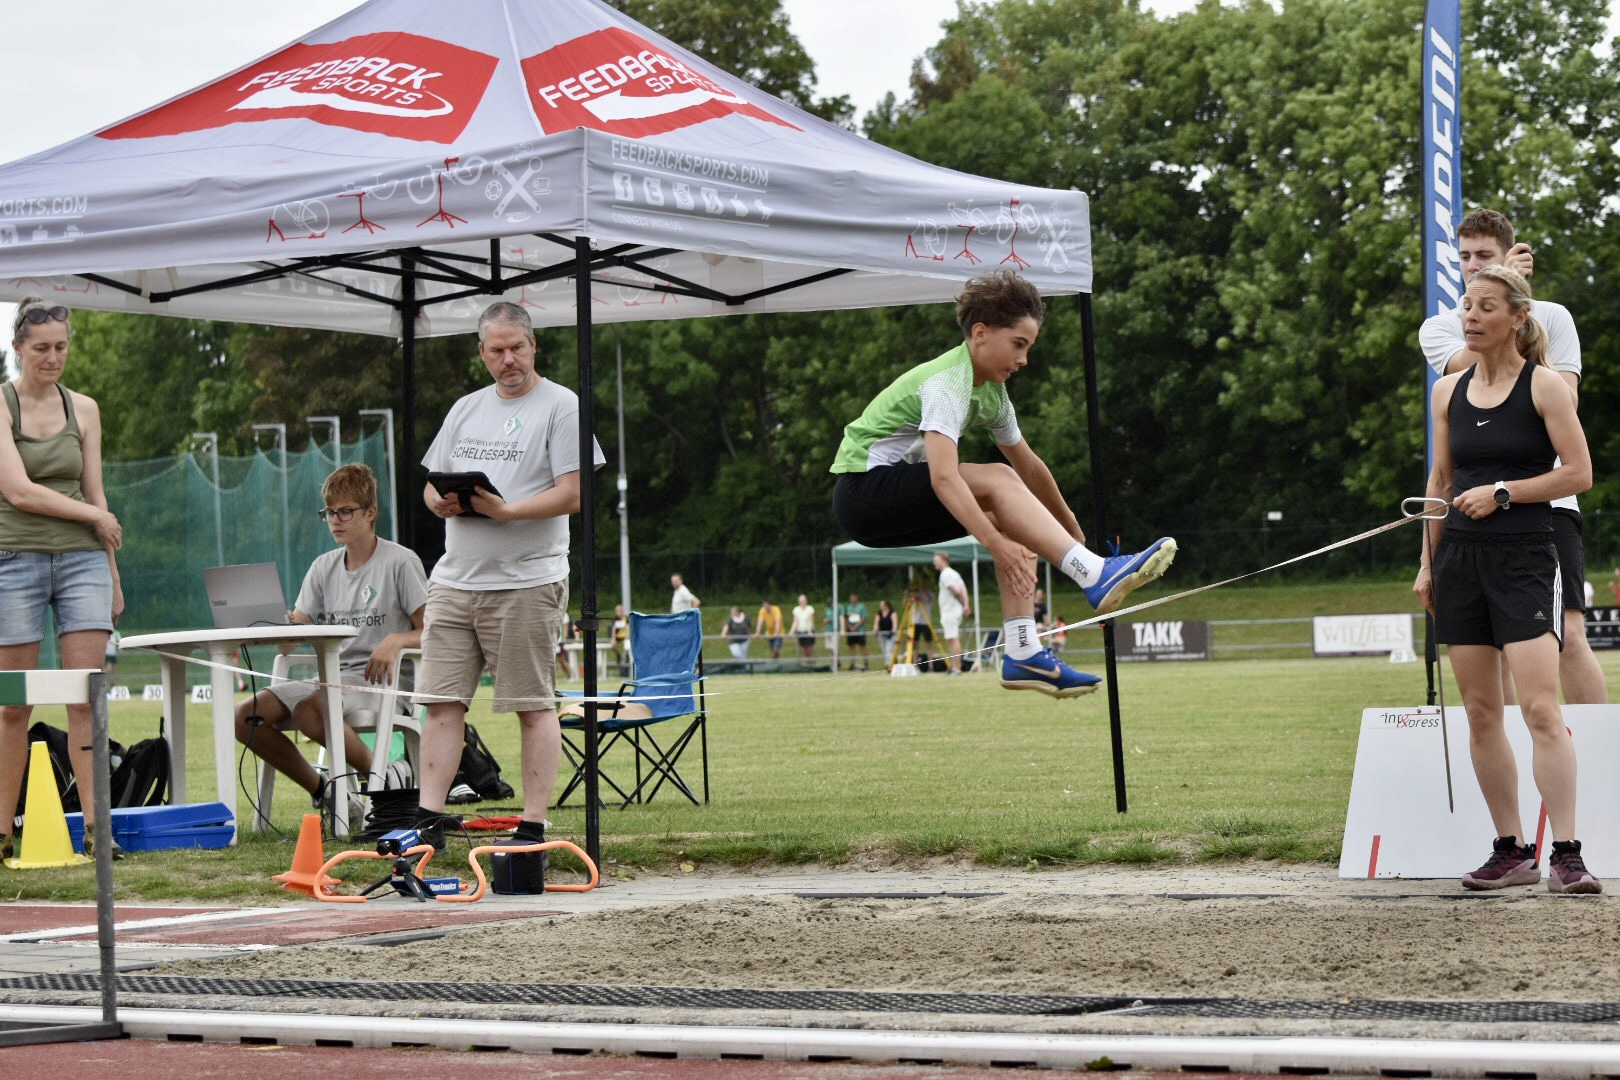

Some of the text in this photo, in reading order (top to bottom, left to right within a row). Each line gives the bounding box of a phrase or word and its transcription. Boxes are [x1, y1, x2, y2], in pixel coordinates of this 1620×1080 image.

[237, 56, 443, 91] FEEDBACK
[311, 76, 423, 105] SPORTS
[611, 140, 769, 187] FEEDBACKSPORTS.COM
[0, 196, 88, 215] ORTS.COM
[452, 446, 524, 462] SCHELDESPORT
[1132, 621, 1184, 646] TAKK
[148, 686, 162, 698] 30
[196, 687, 213, 700] 40
